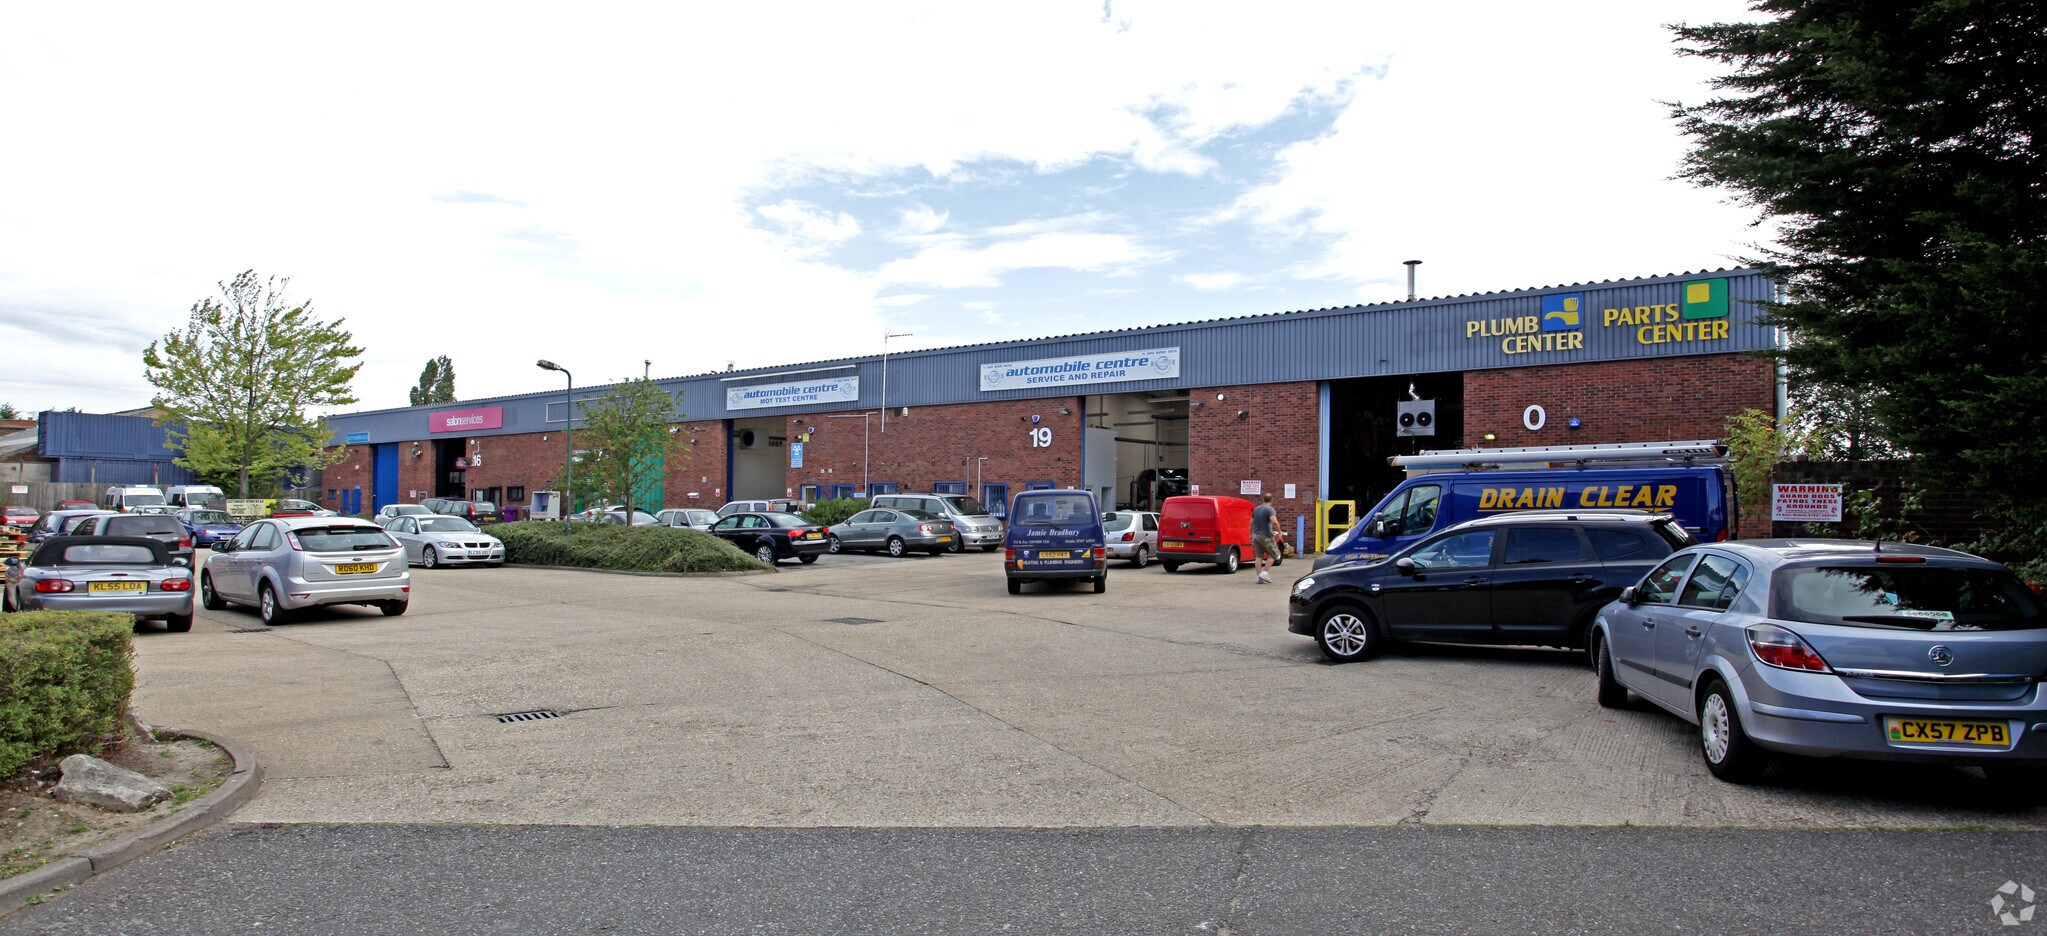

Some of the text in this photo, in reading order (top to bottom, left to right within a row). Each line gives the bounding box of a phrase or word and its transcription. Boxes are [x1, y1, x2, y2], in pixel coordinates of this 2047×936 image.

[1603, 303, 1679, 327] PARTS
[1466, 315, 1539, 338] PLUMB
[1637, 320, 1729, 345] CENTER
[1502, 331, 1583, 354] CENTER
[1006, 362, 1090, 377] automobile
[1096, 357, 1149, 369] centre
[1026, 370, 1126, 384] SERVICE AND REPAIR
[743, 386, 800, 399] automobile
[803, 384, 838, 394] centre
[792, 394, 818, 402] CENTRE
[1029, 427, 1052, 448] 19
[471, 455, 482, 467] 16
[1479, 484, 1678, 508] DRAIN CLEAR
[1026, 528, 1080, 537] Jamie Bradbury
[1902, 721, 2004, 742] CX57 ZPB
